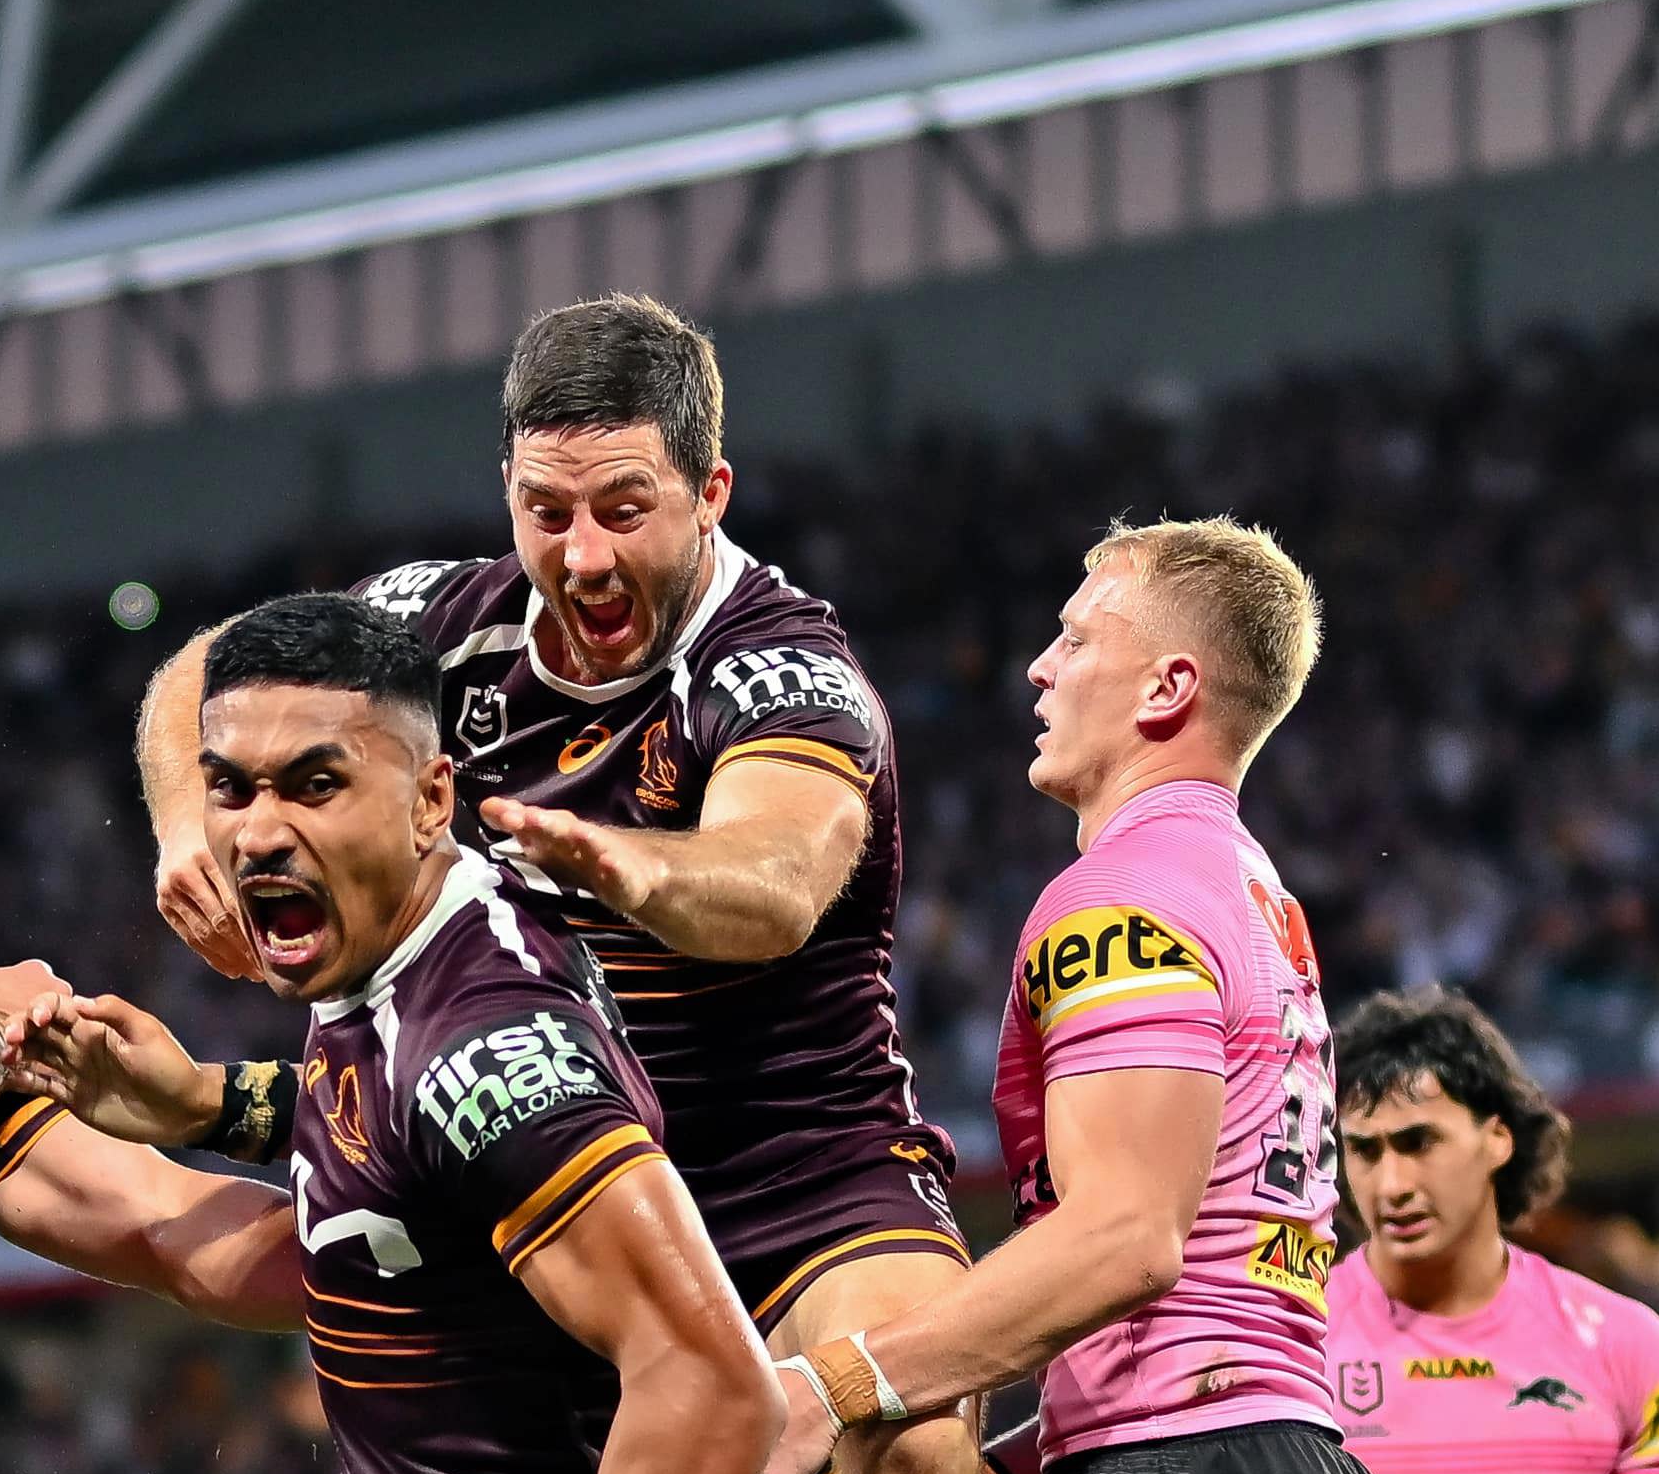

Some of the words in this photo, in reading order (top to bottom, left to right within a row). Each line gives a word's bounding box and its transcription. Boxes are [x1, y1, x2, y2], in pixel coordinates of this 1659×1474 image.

[752, 692, 807, 720] CAR
[415, 1011, 577, 1128] first
[445, 1049, 597, 1160] mac
[465, 1113, 513, 1161] CAR
[515, 1082, 599, 1123] LOANS
[1407, 1359, 1495, 1379] ALLAM
